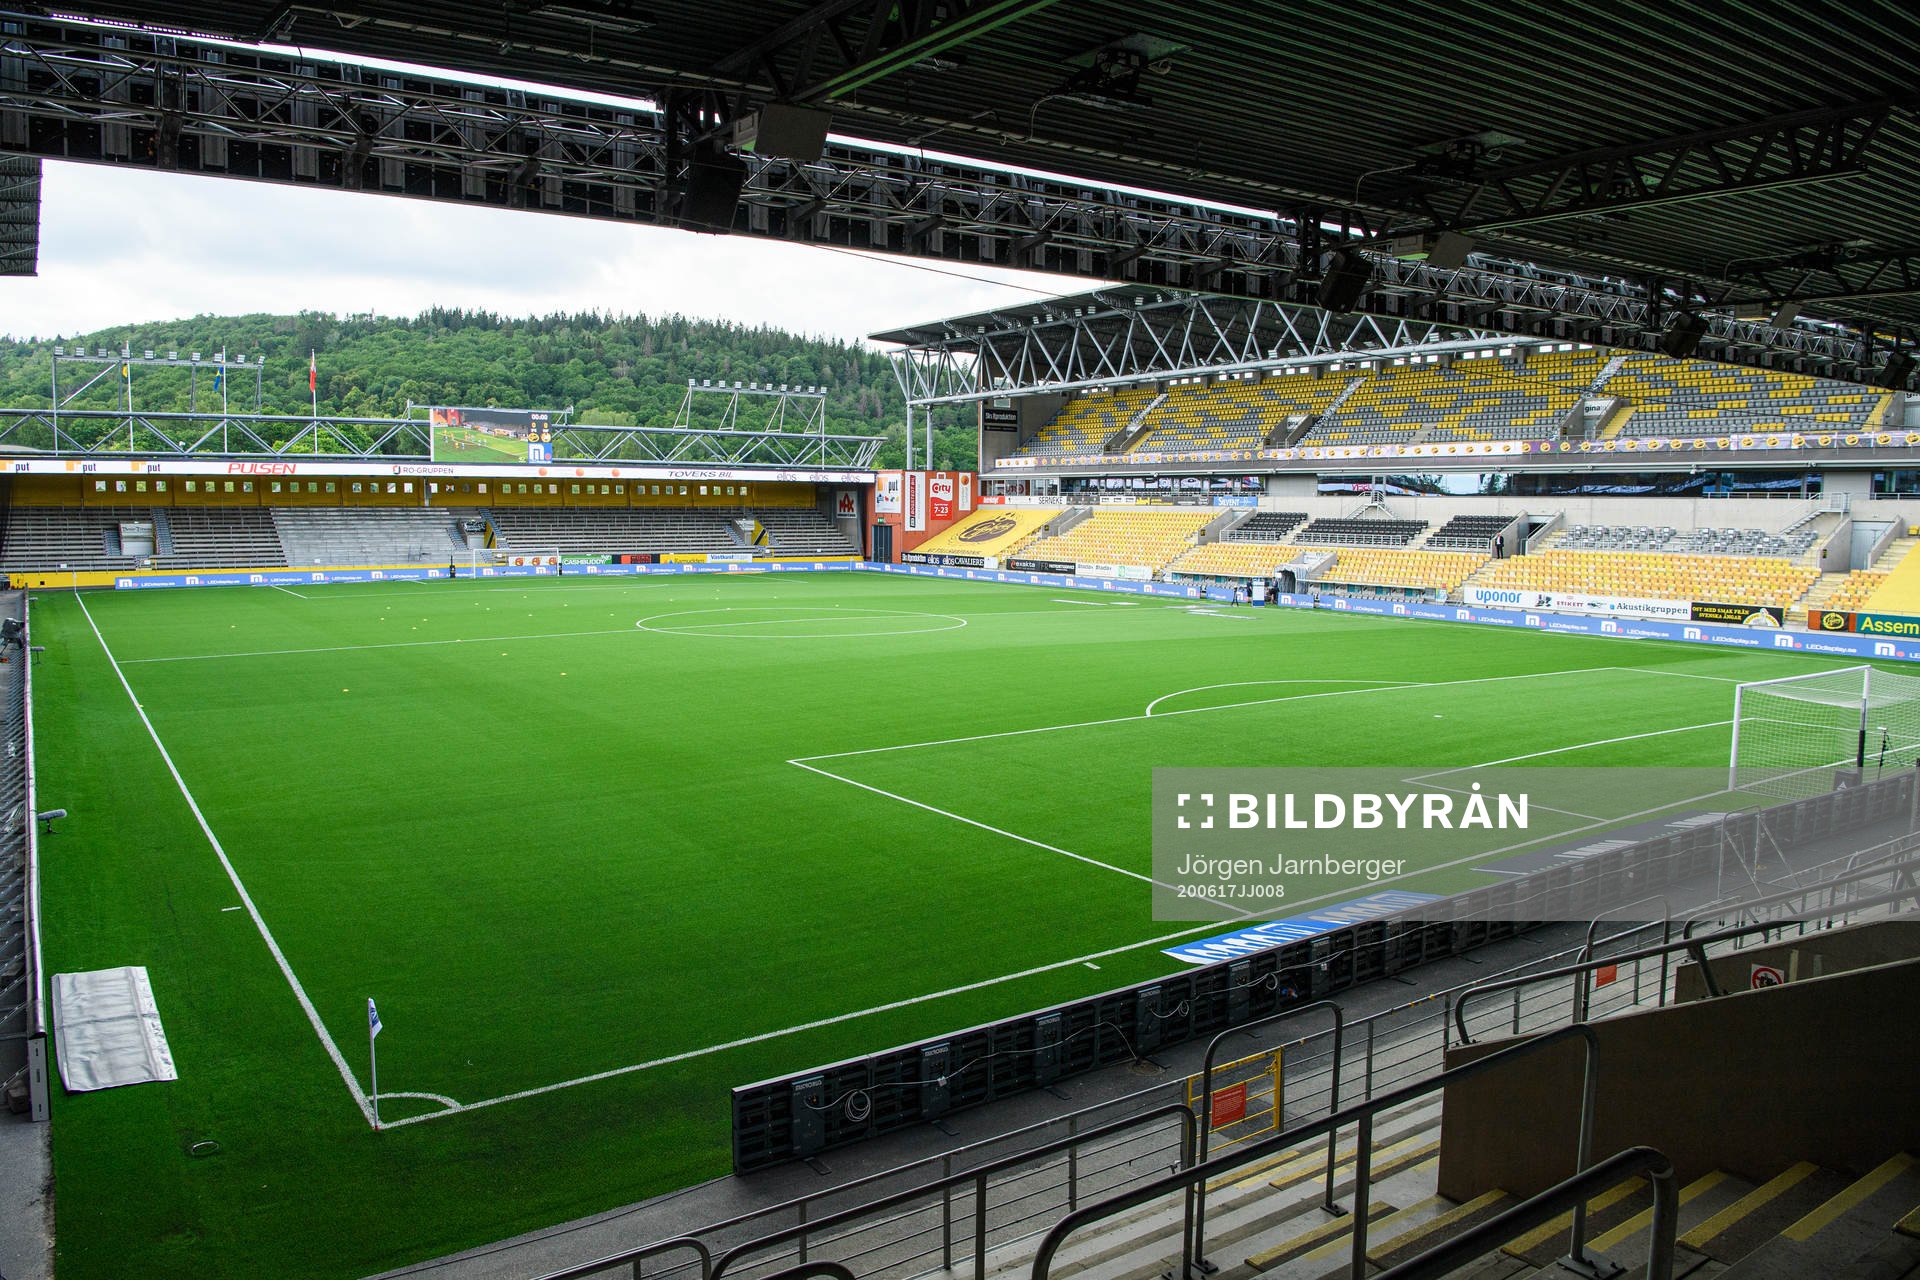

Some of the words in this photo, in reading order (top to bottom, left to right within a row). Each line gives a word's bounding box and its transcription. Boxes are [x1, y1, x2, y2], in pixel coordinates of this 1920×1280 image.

[15, 462, 30, 474] put
[82, 462, 97, 473] put
[147, 463, 161, 474] put
[227, 463, 297, 474] PULSEN
[888, 480, 898, 494] put
[1038, 496, 1063, 504] SERNEKE
[934, 506, 949, 514] 7-23
[1476, 590, 1522, 604] uponor
[1616, 602, 1688, 614] Akustikgruppen
[1860, 617, 1920, 634] Assem
[1627, 629, 1669, 637] LEDdisplay.se
[1712, 636, 1759, 645] LEDdisplay.se
[1806, 643, 1856, 653] LEDdisplay.se
